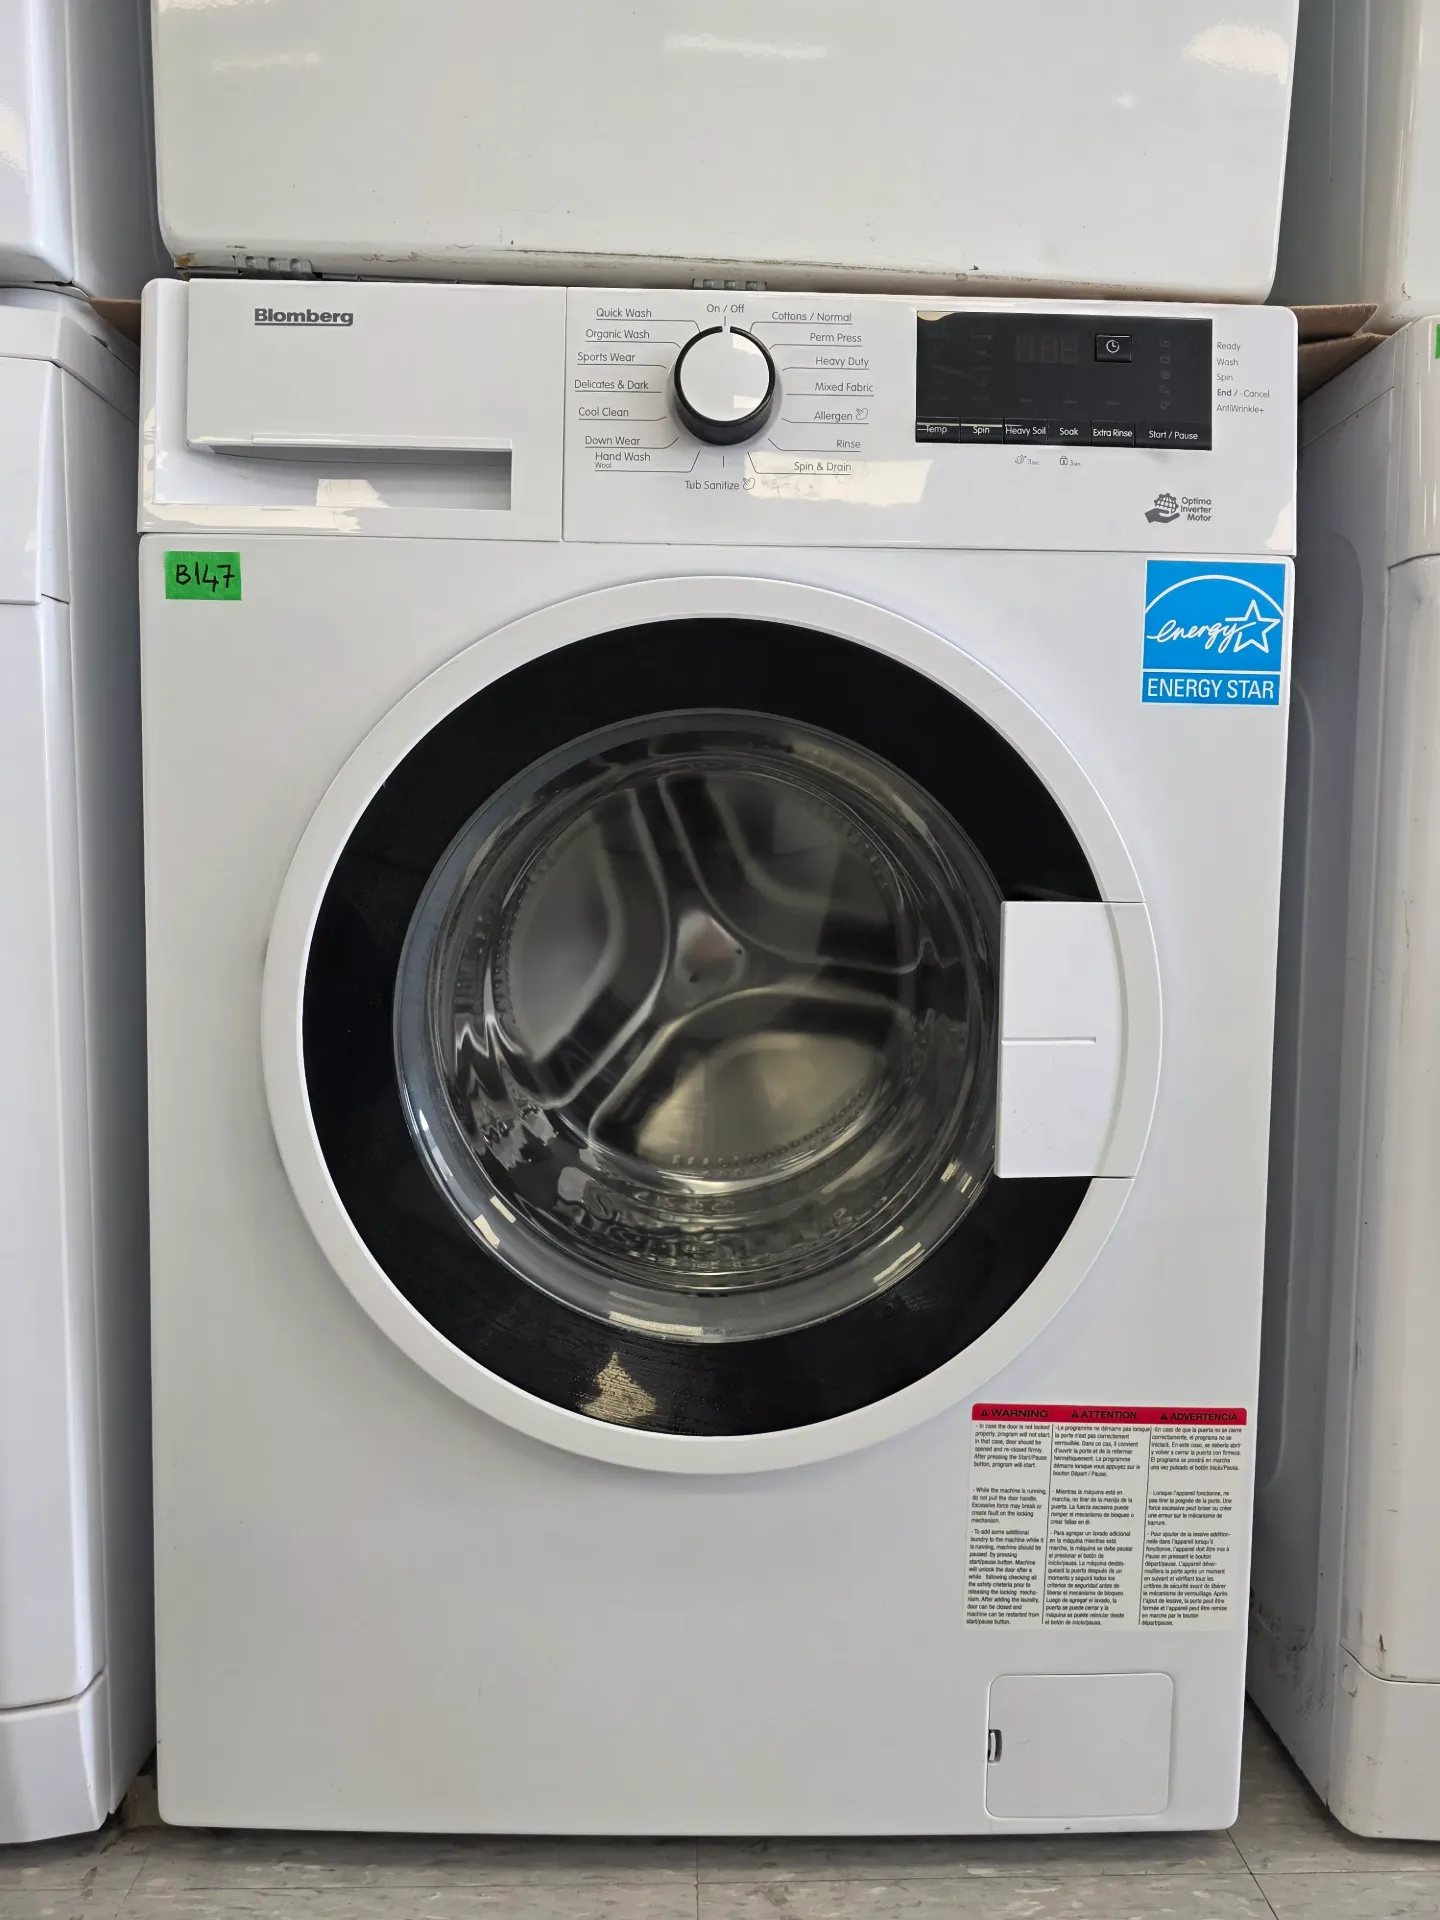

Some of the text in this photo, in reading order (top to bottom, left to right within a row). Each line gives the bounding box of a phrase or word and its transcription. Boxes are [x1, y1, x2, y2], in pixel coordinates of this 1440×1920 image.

[596, 308, 651, 318] Quick Wash
[707, 304, 720, 313] On
[731, 304, 744, 313] Off
[254, 308, 353, 327] Blomberg
[772, 312, 852, 322] Cottons / Normal
[586, 329, 650, 340] Organic Wash
[810, 333, 861, 343] Perm Press
[1217, 342, 1241, 351] Ready
[577, 352, 635, 363] Sports Wear
[816, 357, 869, 368] Heavy Duty
[1217, 358, 1238, 366] Wash
[1217, 374, 1233, 382] Spin
[575, 380, 649, 389] Delicates & Dark
[815, 383, 873, 392] Mixed Fabric
[1217, 389, 1232, 397] End
[579, 407, 628, 417] Cool Clean
[814, 411, 852, 422] Allergen
[972, 425, 990, 436] Spin
[1006, 427, 1030, 436] Heavy
[1059, 427, 1079, 436] Soak
[1093, 428, 1133, 438] Extra Rinse
[1148, 430, 1199, 440] Start / Pause
[585, 436, 640, 445] Down Wear
[837, 440, 861, 448] Rinse
[595, 452, 650, 462] Hand Wash
[794, 462, 851, 472] Spin & Drain
[685, 481, 739, 490] Tub Sanitize
[1182, 497, 1211, 505] Optima
[175, 561, 236, 592] B147
[1146, 620, 1256, 653] energy
[1148, 678, 1274, 699] ENERGY STAR
[991, 1409, 1048, 1418] WARNING
[1081, 1411, 1137, 1419] ATTENTION
[1170, 1413, 1238, 1421] ADVERTENCIA
